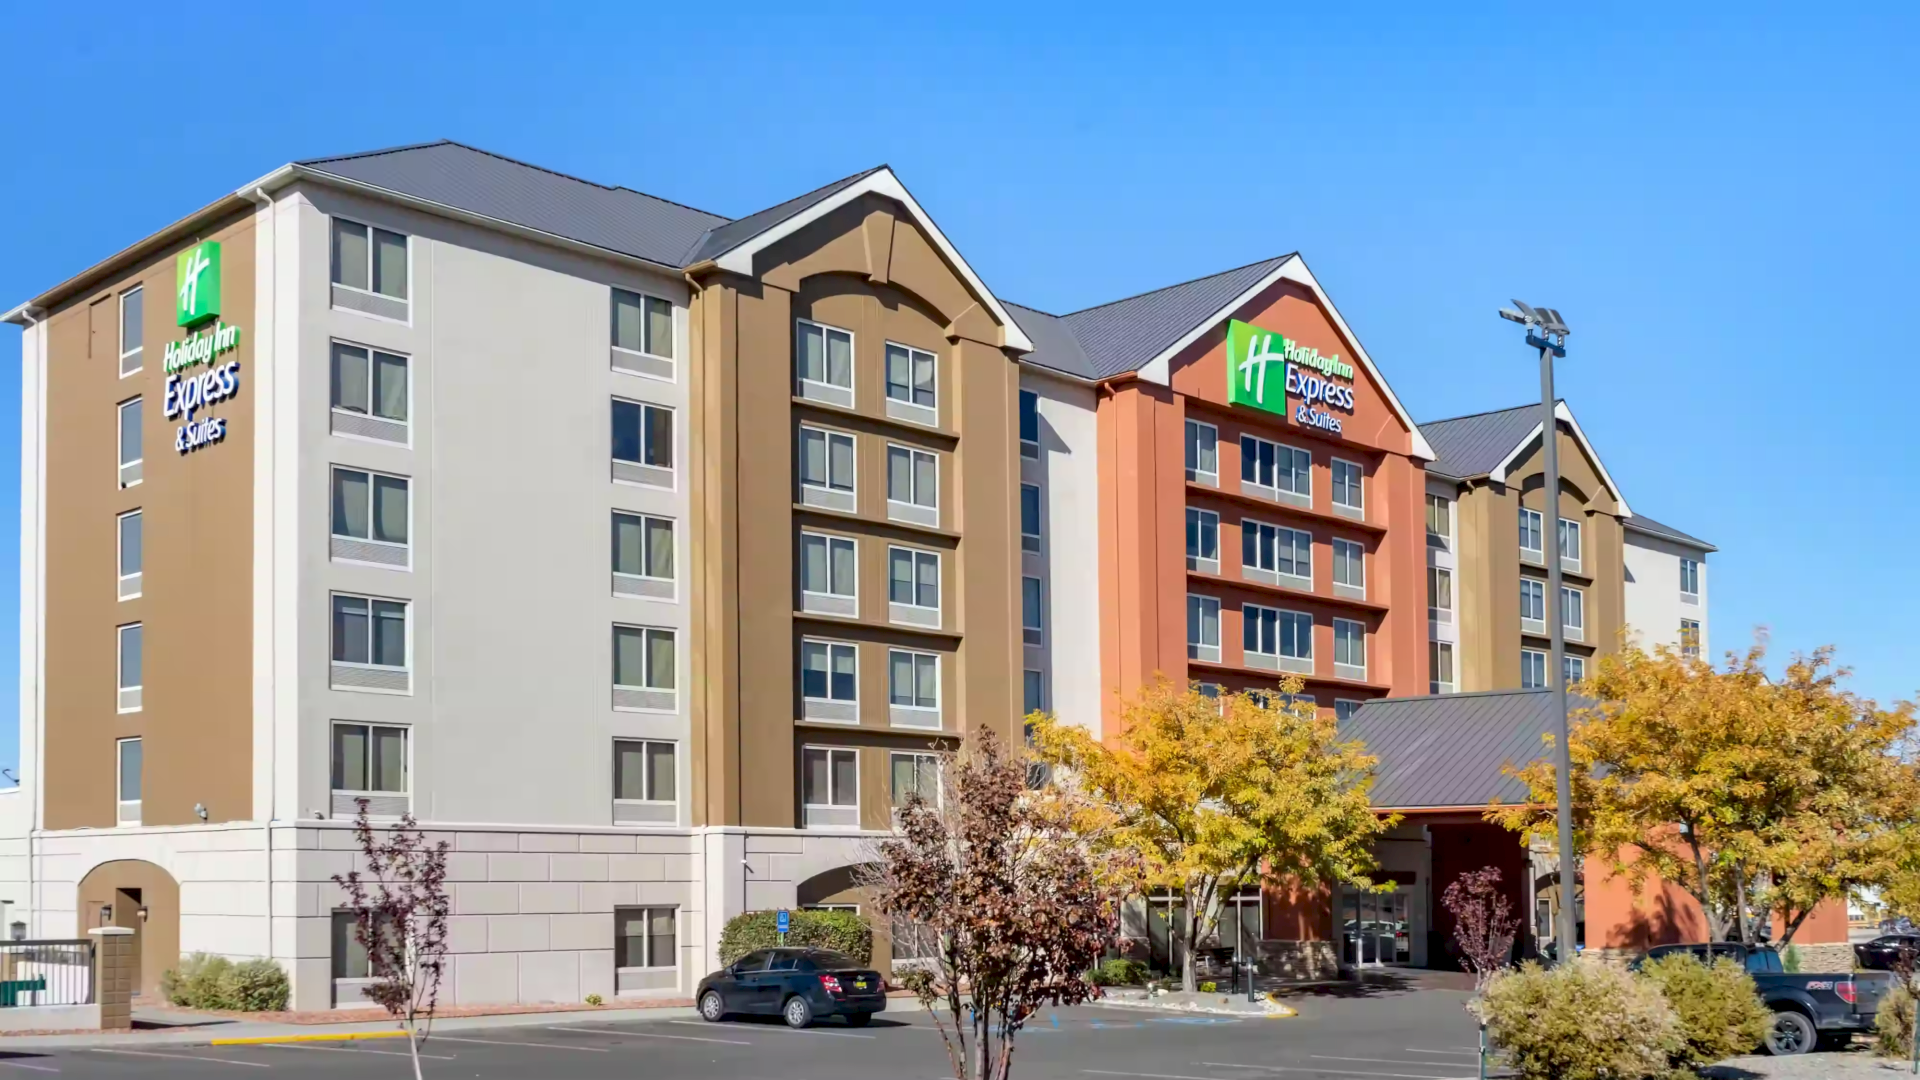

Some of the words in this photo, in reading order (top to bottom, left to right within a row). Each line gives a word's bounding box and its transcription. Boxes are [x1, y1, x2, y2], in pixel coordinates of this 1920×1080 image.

[163, 331, 214, 373] Holiday
[214, 321, 236, 352] Inn
[1283, 338, 1332, 377] Holiday
[1332, 354, 1353, 379] Inn
[163, 361, 237, 421] Express
[1285, 362, 1354, 410] Express
[175, 426, 188, 452] &
[186, 417, 223, 448] Suites
[1296, 404, 1307, 424] &
[1308, 408, 1342, 433] Suites
